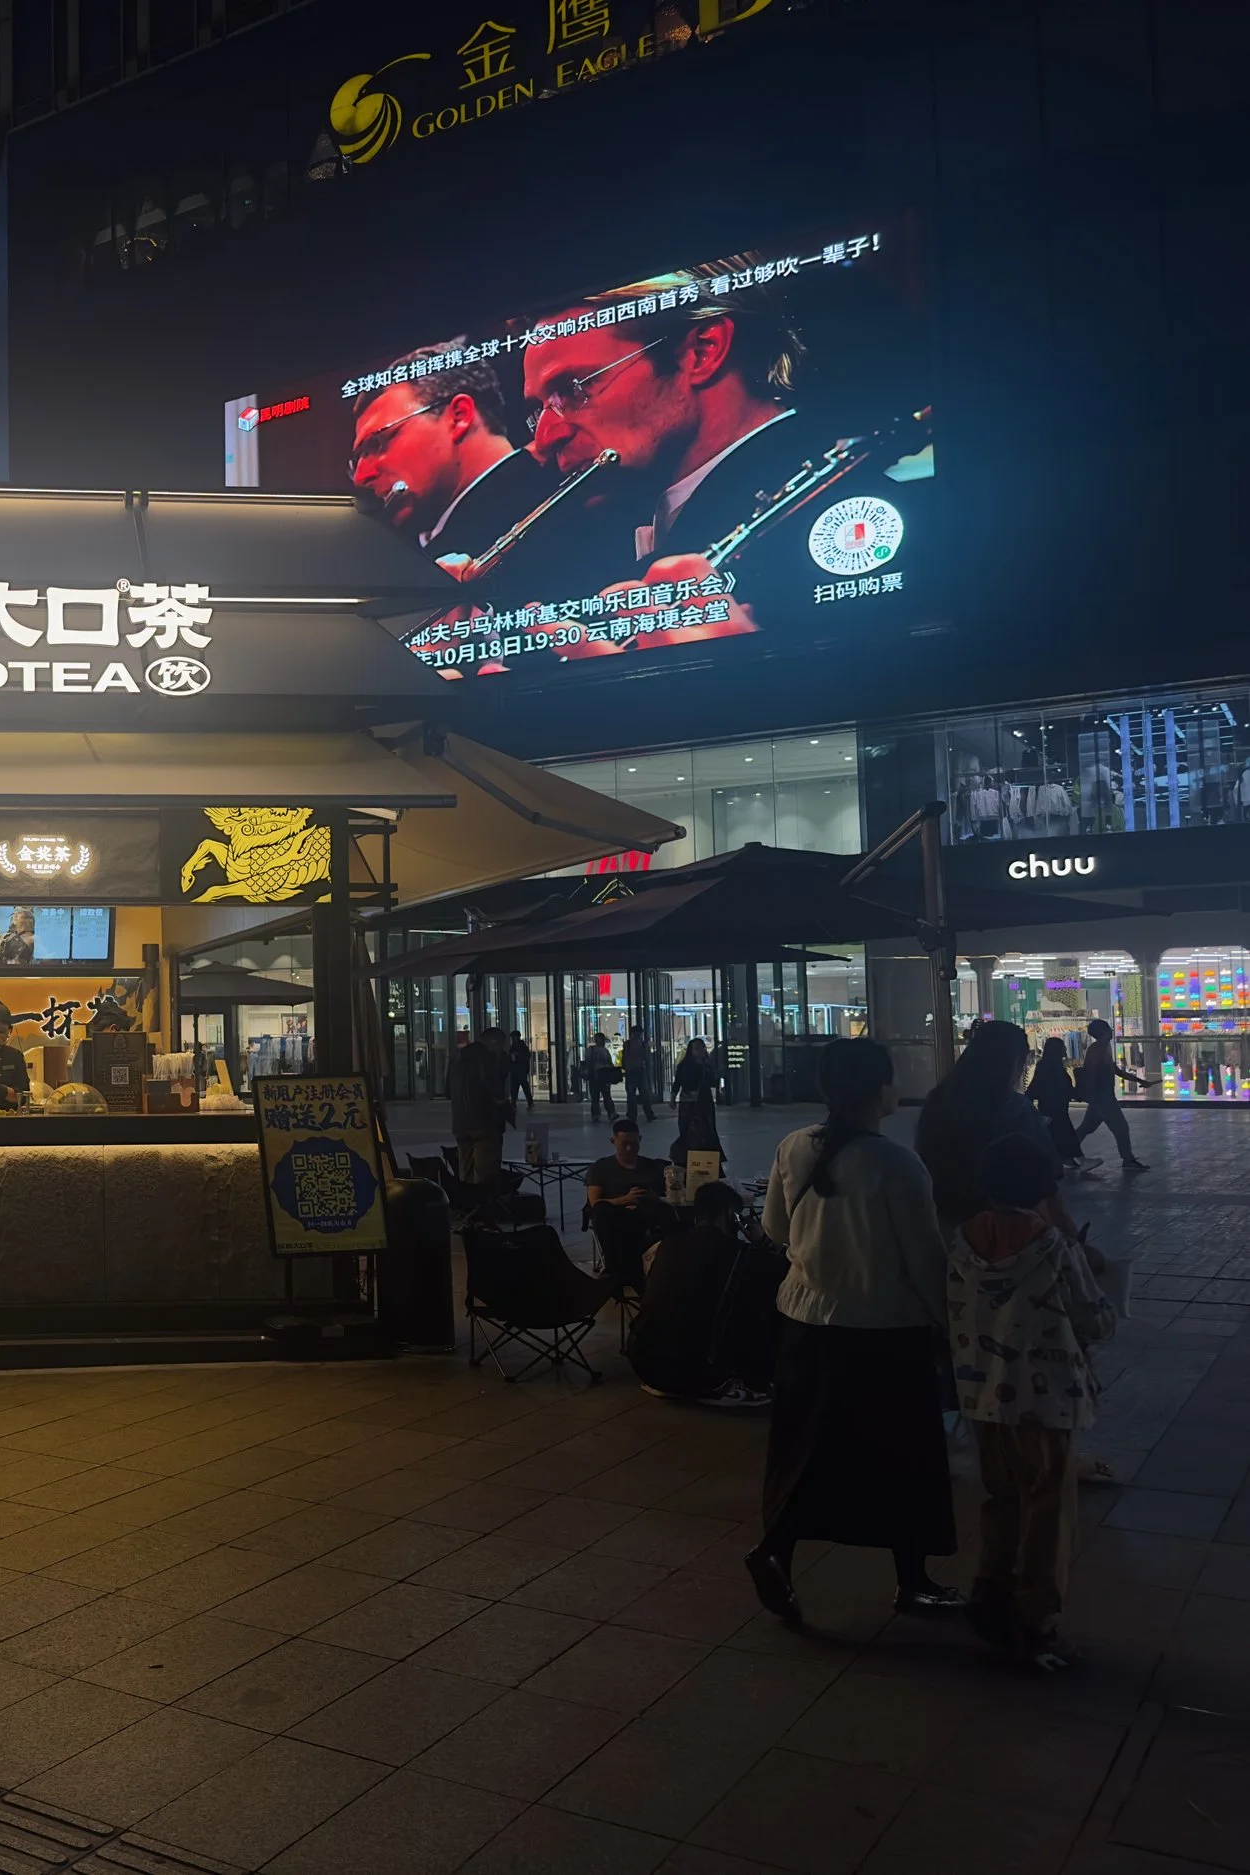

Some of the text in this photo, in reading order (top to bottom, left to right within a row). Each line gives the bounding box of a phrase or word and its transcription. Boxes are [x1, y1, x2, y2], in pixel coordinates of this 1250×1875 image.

[457, 0, 612, 90] 金鹰
[411, 33, 655, 139] GOLDEN EAGLE
[341, 283, 699, 399] 全球知名指挥携全球十大交响乐团西南首秀
[813, 572, 903, 604] 扫码购票
[405, 571, 737, 649] 耶夫与马林斯基交响乐团音乐会》
[584, 600, 730, 642] 云南海埂会堂
[1008, 853, 1095, 879] chuu
[262, 1083, 365, 1102] 新用户注册会员
[264, 1102, 368, 1132] 赠送2元
